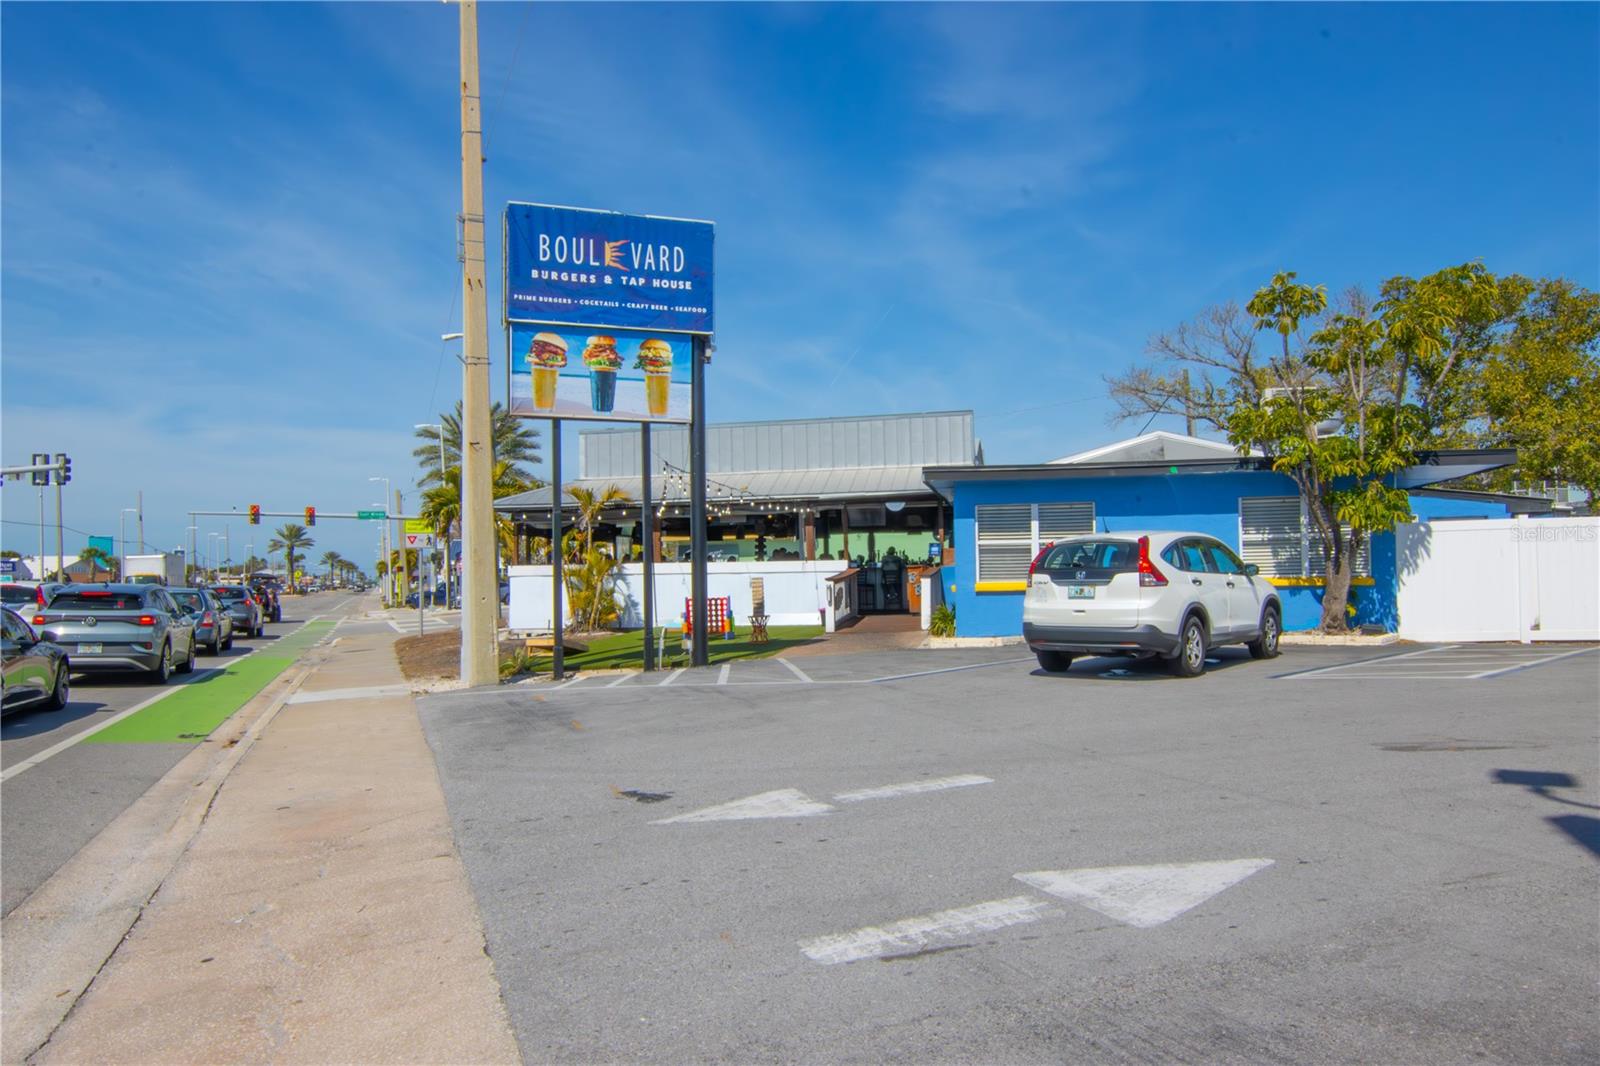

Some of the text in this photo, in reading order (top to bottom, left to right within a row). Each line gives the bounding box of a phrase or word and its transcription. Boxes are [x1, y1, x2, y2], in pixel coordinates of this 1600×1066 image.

[538, 233, 685, 273] BOULEVARD
[531, 269, 692, 290] BURGERS & TAP HOUSE
[513, 293, 537, 302] PRIME
[538, 296, 572, 305] BURGERS
[579, 299, 619, 308] COCKTAILS
[627, 302, 649, 310] CRAFT
[674, 306, 708, 314] SEAFOOD
